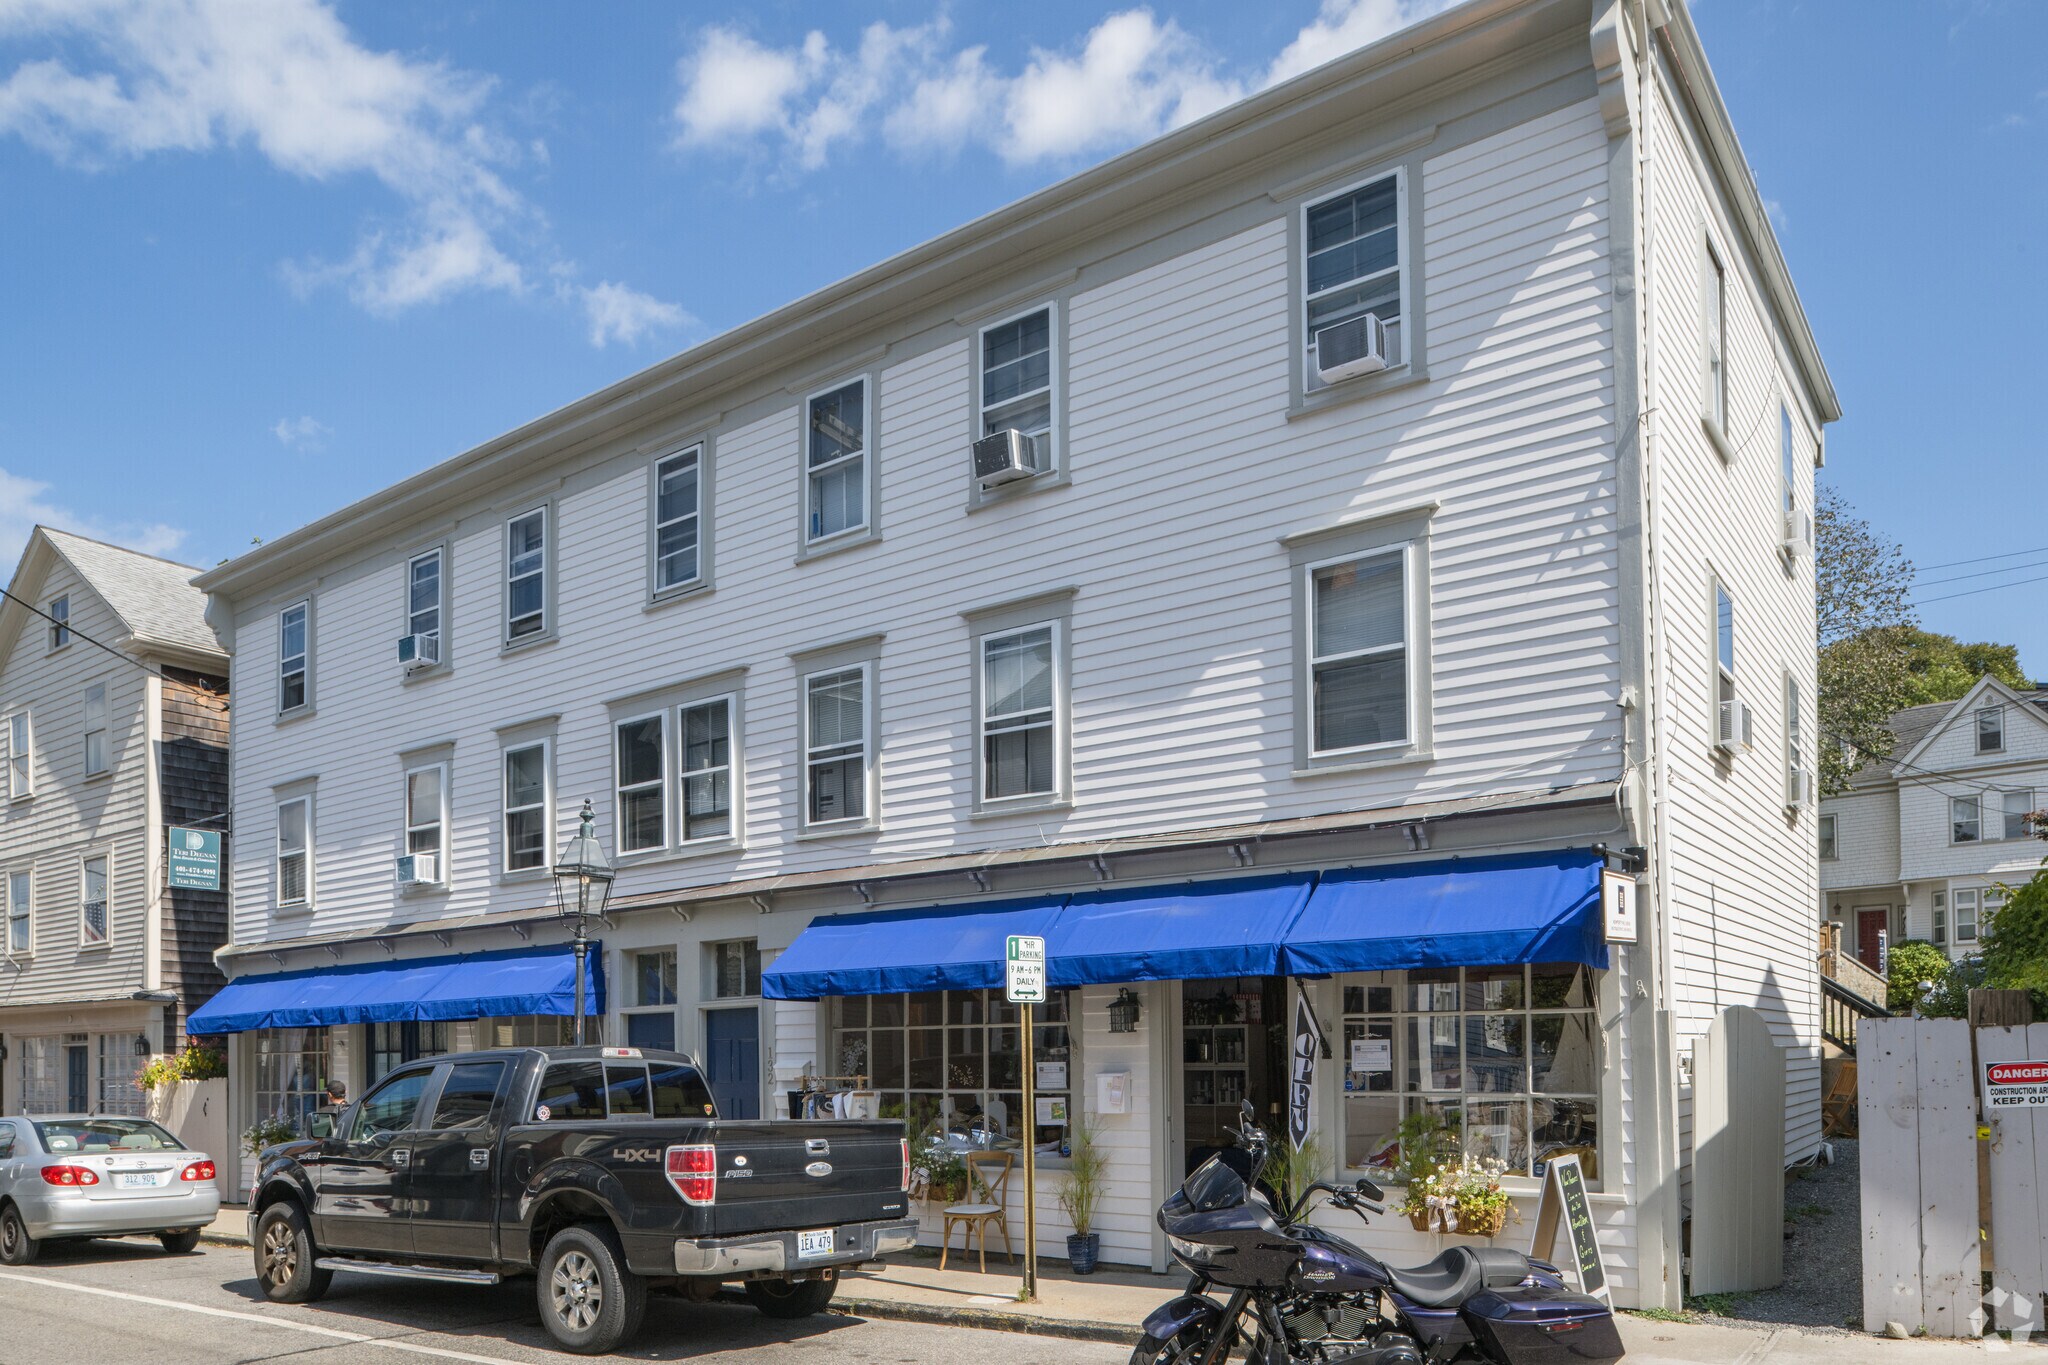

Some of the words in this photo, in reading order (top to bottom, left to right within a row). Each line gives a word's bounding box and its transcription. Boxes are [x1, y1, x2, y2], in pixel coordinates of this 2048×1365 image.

[1011, 940, 1016, 958] 1
[1026, 940, 1036, 949] HR
[1020, 950, 1042, 959] PARKING
[1011, 965, 1015, 974] 9
[1033, 966, 1042, 974] PM
[1016, 977, 1036, 986] DAILY
[1993, 1067, 2048, 1079] DANGER
[1990, 1086, 2038, 1096] CONSTRUCTION
[2039, 1086, 2048, 1094] AR
[1993, 1096, 2025, 1105] KEEP
[613, 1148, 661, 1163] 4X4
[125, 1174, 138, 1184] 312
[141, 1174, 155, 1183] 909
[801, 1237, 815, 1251] 1EA
[818, 1235, 832, 1249] 479
